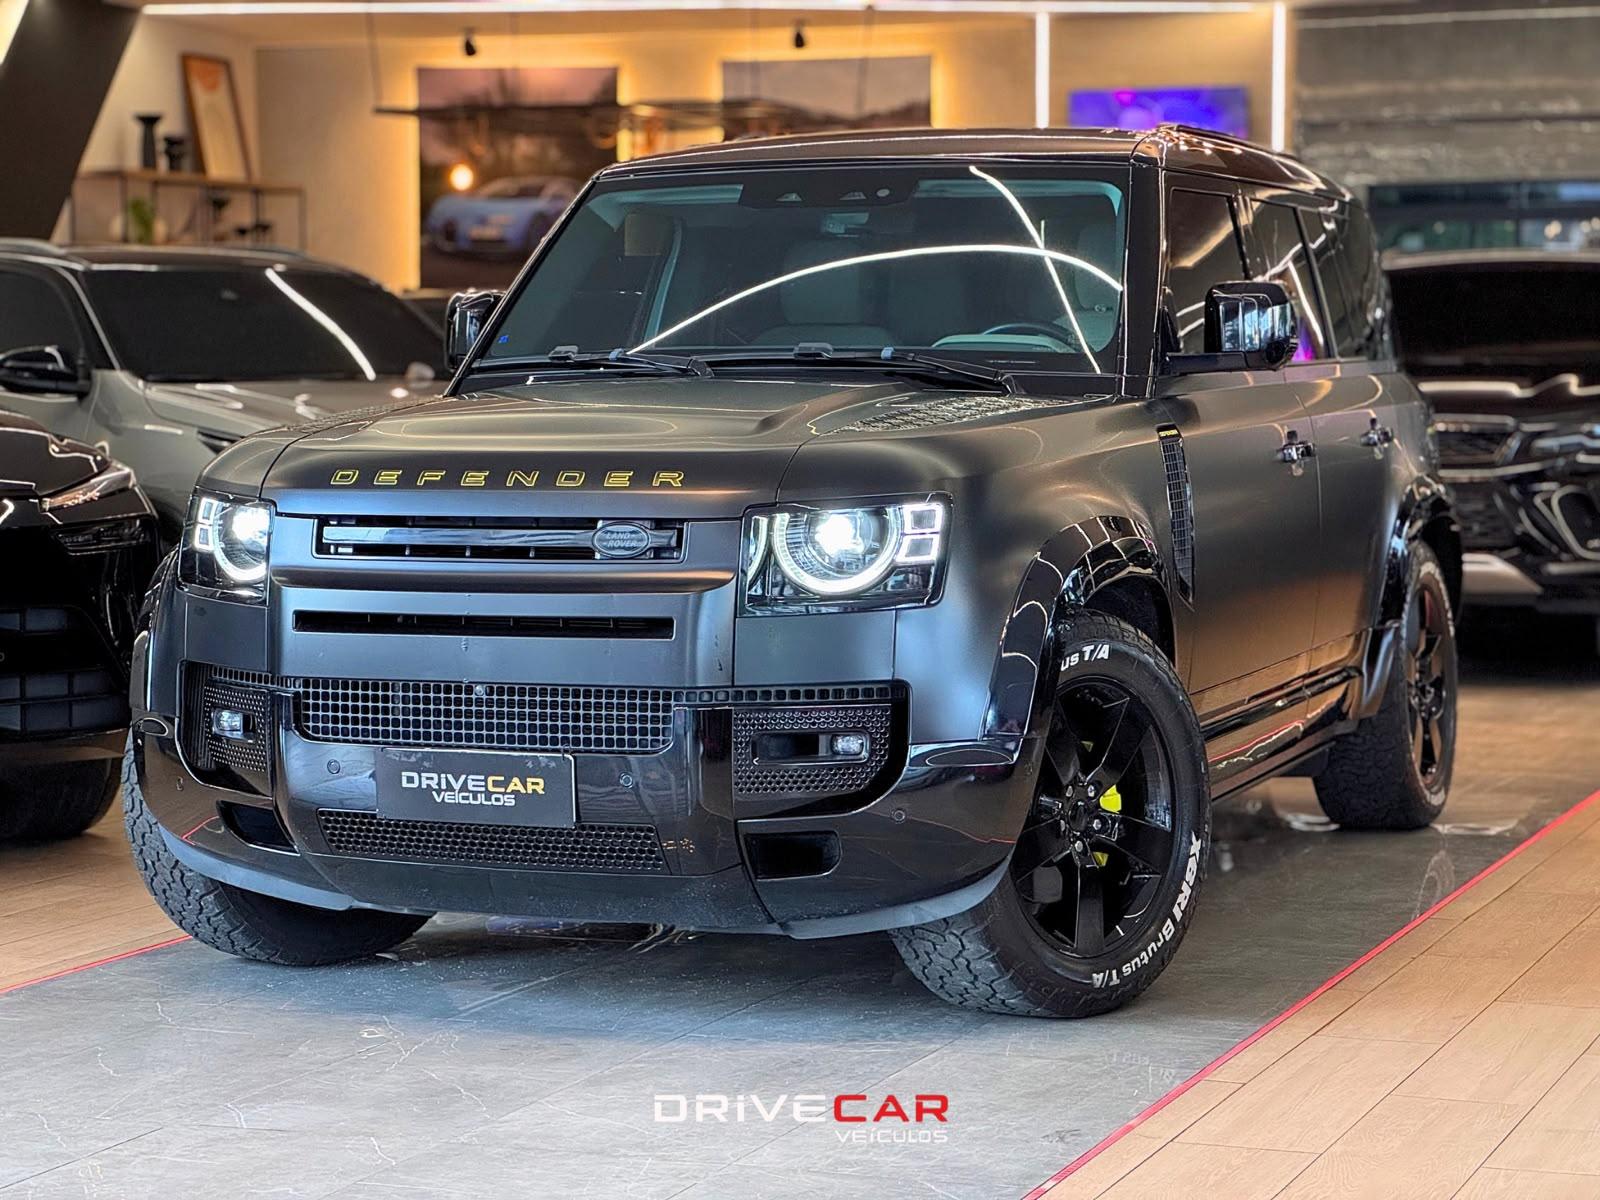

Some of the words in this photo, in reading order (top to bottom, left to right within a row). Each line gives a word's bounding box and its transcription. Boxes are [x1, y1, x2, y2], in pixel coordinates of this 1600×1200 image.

[330, 469, 685, 487] DEFENDER
[606, 532, 631, 540] LAND
[607, 540, 638, 548] ROVER
[1081, 643, 1110, 662] T/A
[1172, 829, 1202, 923] XBRI
[1121, 917, 1176, 977] Brutus
[1091, 968, 1121, 989] T/A
